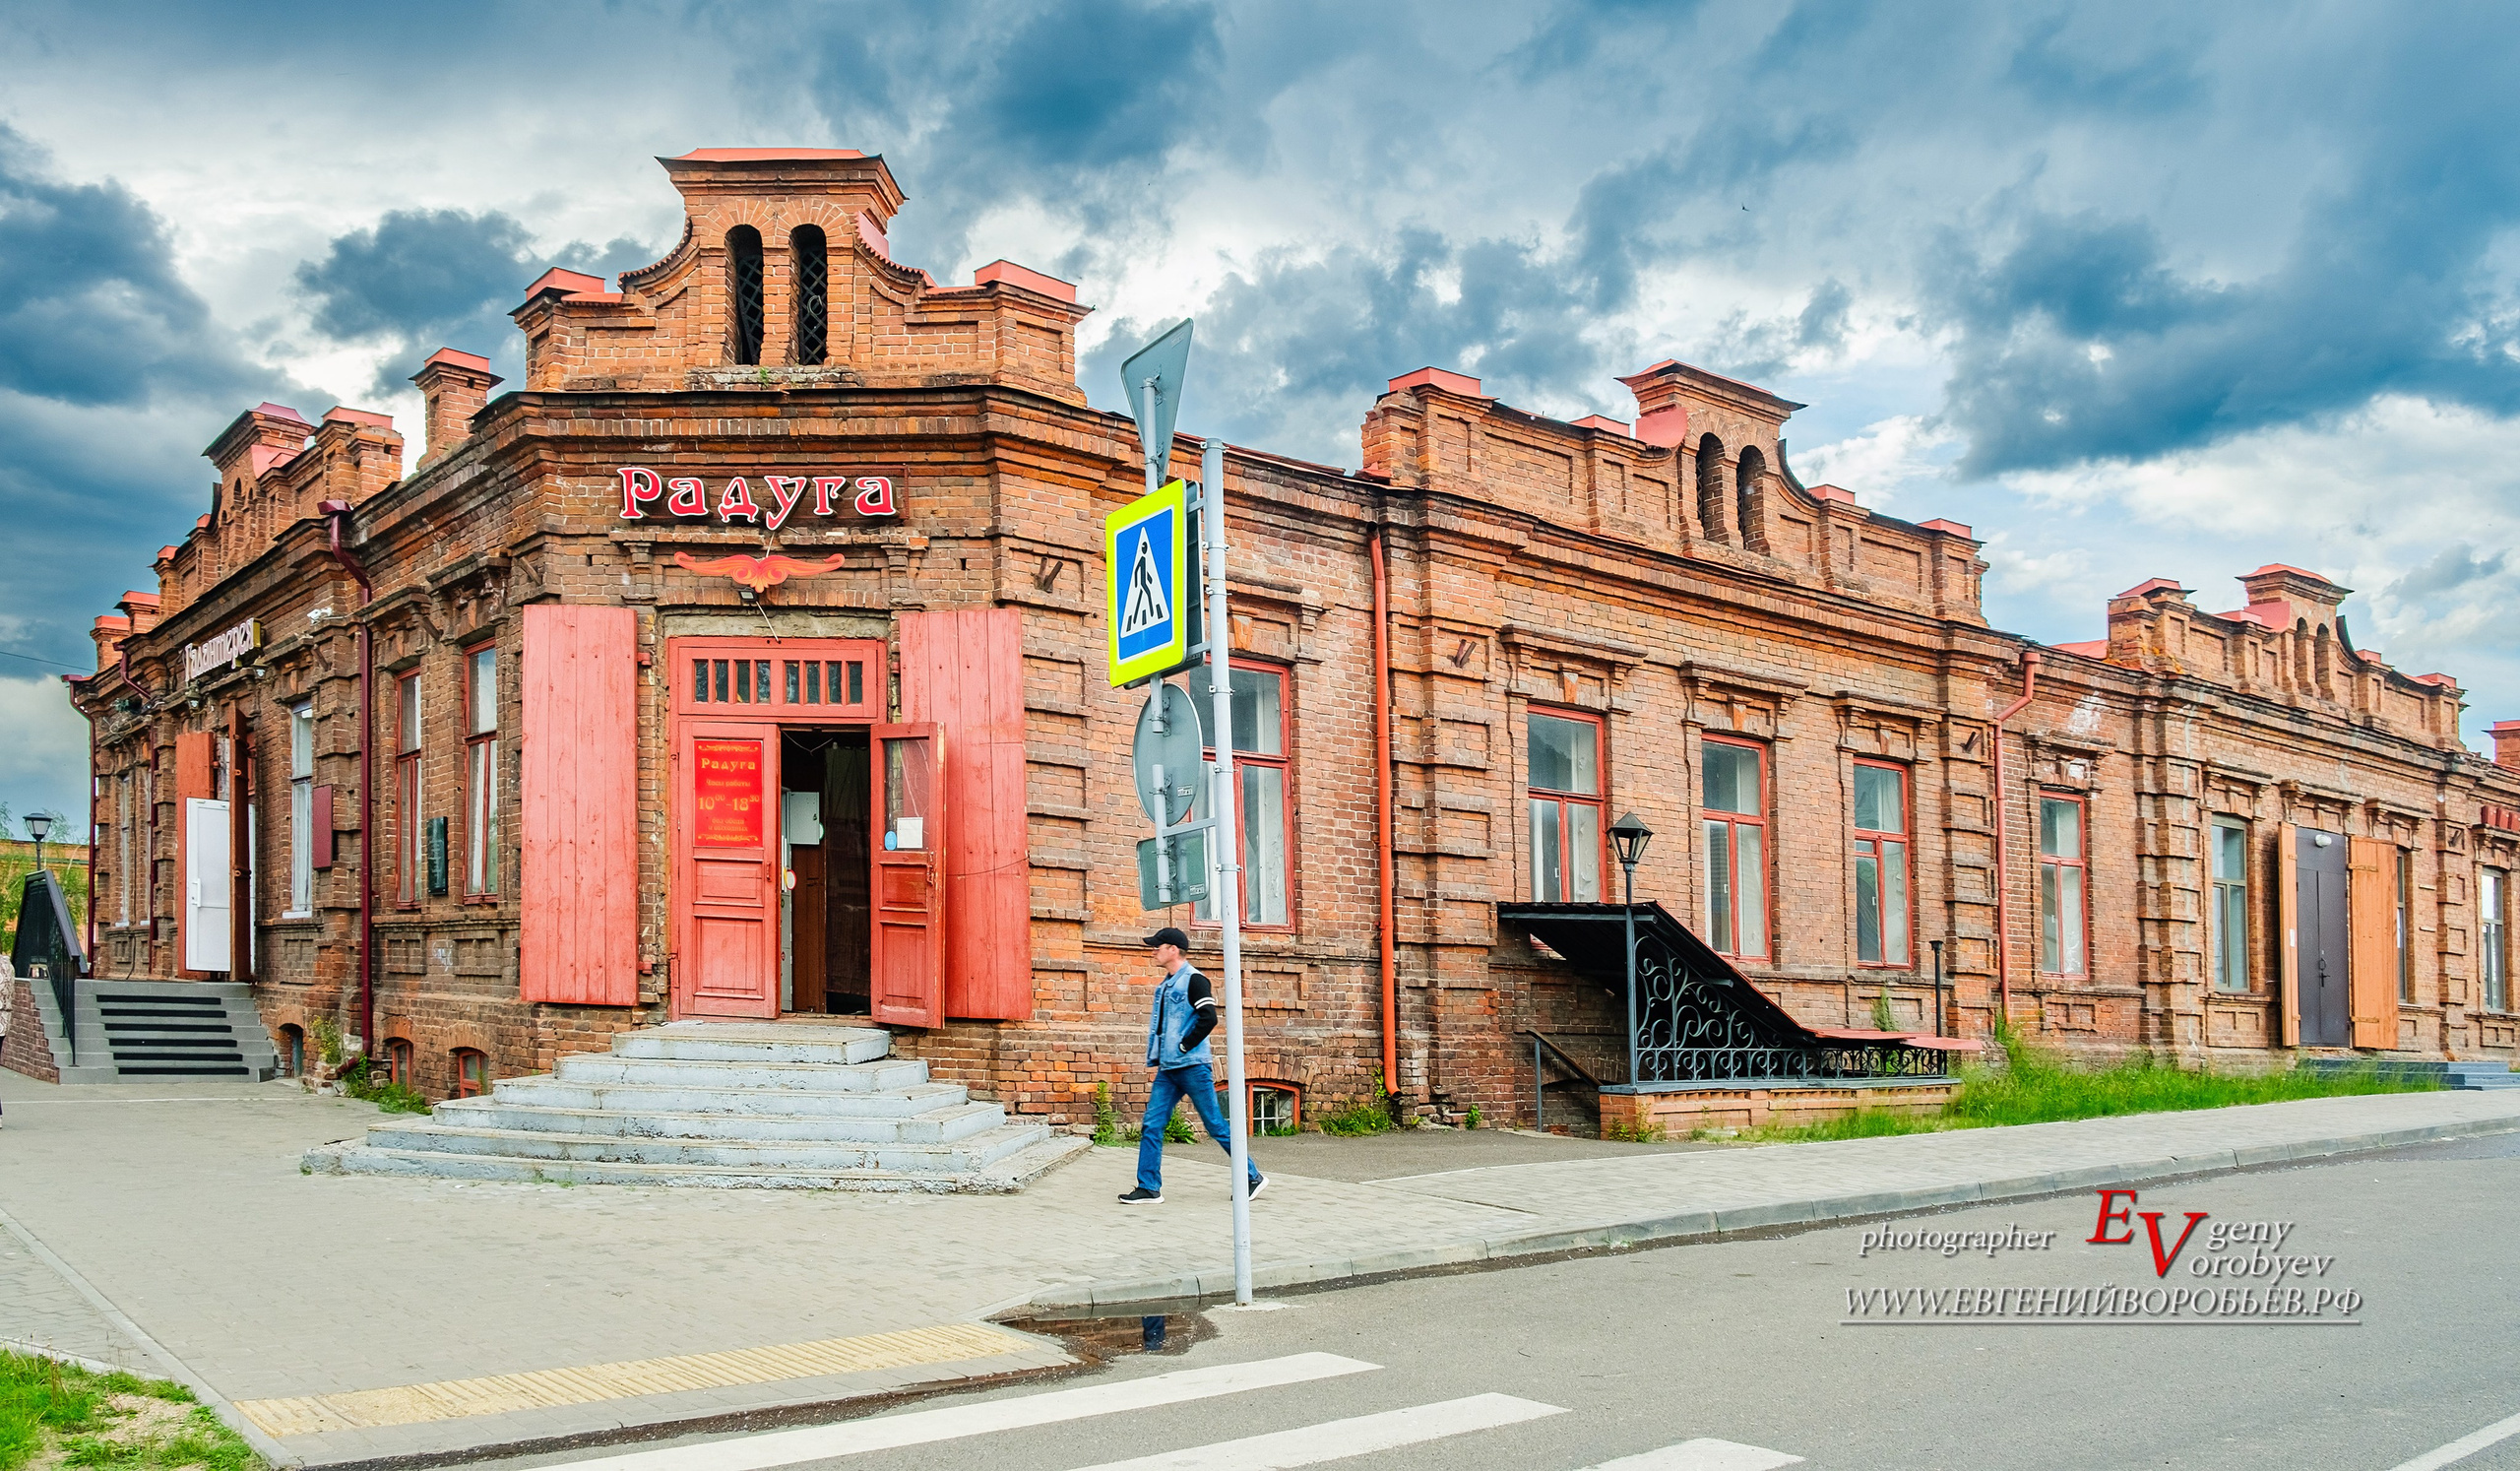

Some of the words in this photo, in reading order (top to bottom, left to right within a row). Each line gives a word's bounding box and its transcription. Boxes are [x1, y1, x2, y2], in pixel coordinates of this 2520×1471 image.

[616, 467, 897, 531] Радуга
[184, 617, 254, 682] Галантерея
[701, 757, 756, 772] Радуга
